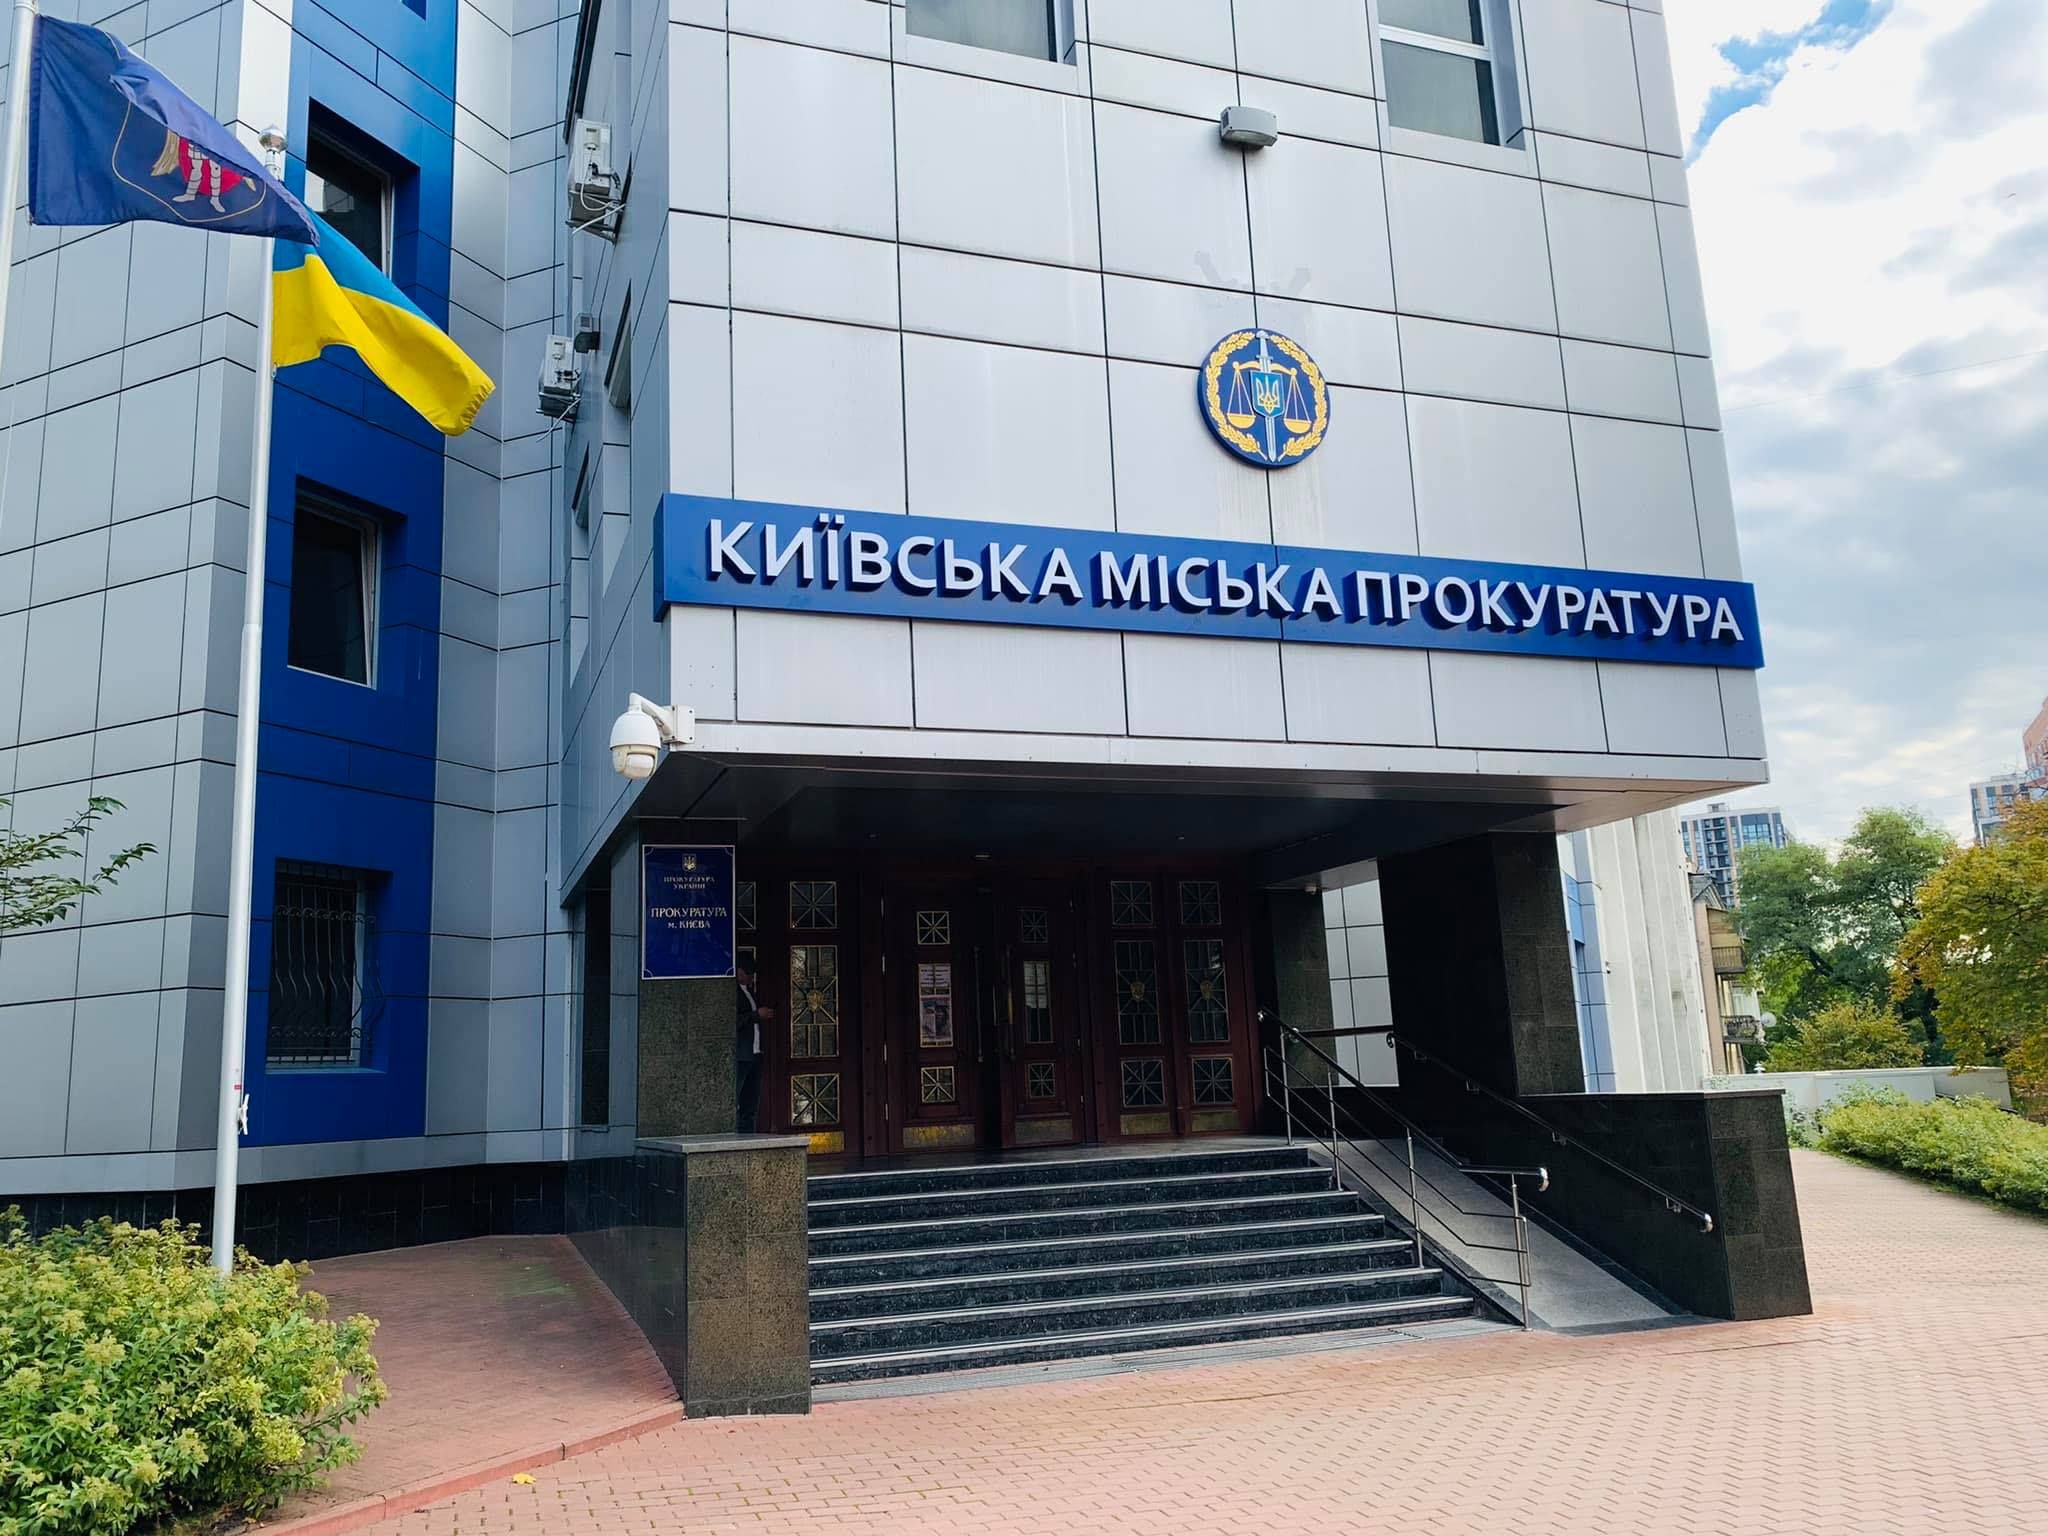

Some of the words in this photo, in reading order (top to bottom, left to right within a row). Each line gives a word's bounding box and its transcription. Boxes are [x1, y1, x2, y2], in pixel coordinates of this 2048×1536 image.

[707, 512, 1084, 600] КИЇВСЬКА
[1099, 550, 1342, 616] МІСЬКА
[1356, 570, 1744, 641] ПРОКУРАТУРА
[650, 906, 728, 918] ПРОКУРАТУРА
